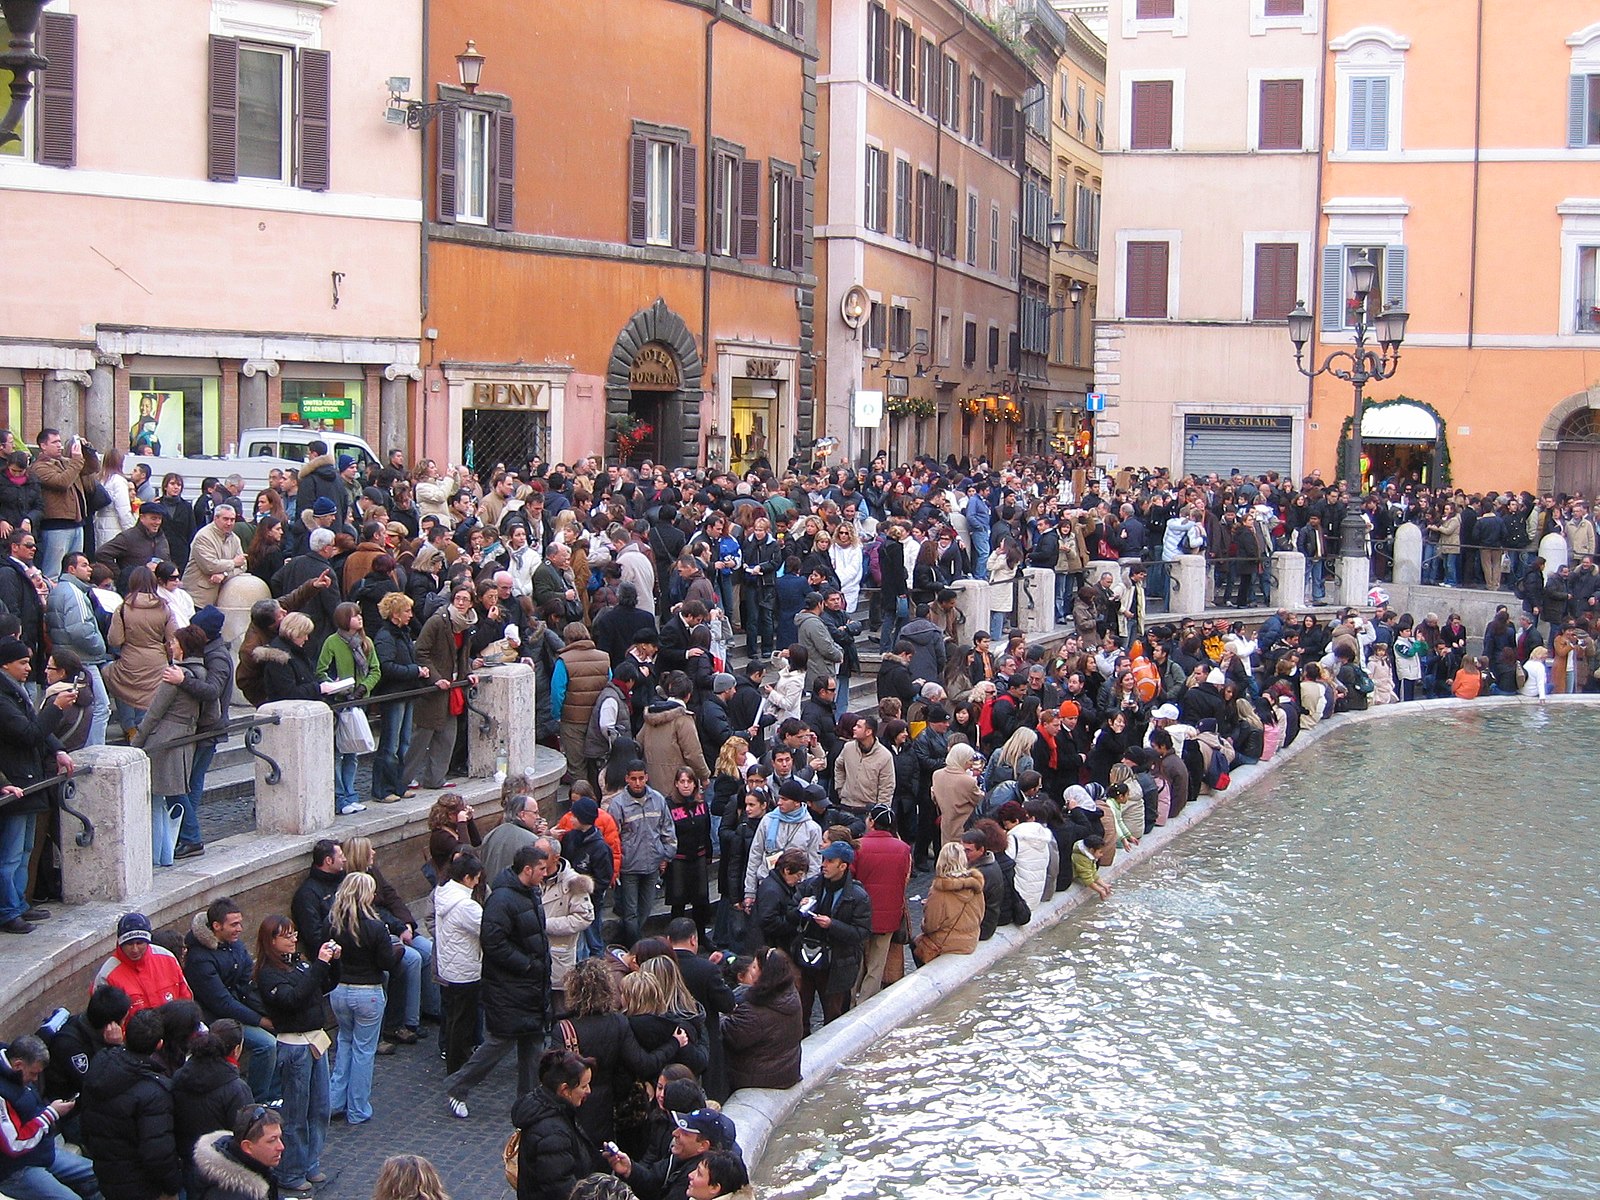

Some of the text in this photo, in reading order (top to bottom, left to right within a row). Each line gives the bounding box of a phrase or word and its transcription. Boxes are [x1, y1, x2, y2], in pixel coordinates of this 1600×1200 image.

[634, 349, 673, 369] HOTEL
[629, 371, 679, 383] FONTANA
[473, 383, 544, 405] BENY
[1002, 380, 1030, 394] BAR
[1200, 417, 1277, 427] PAUL & SHARK
